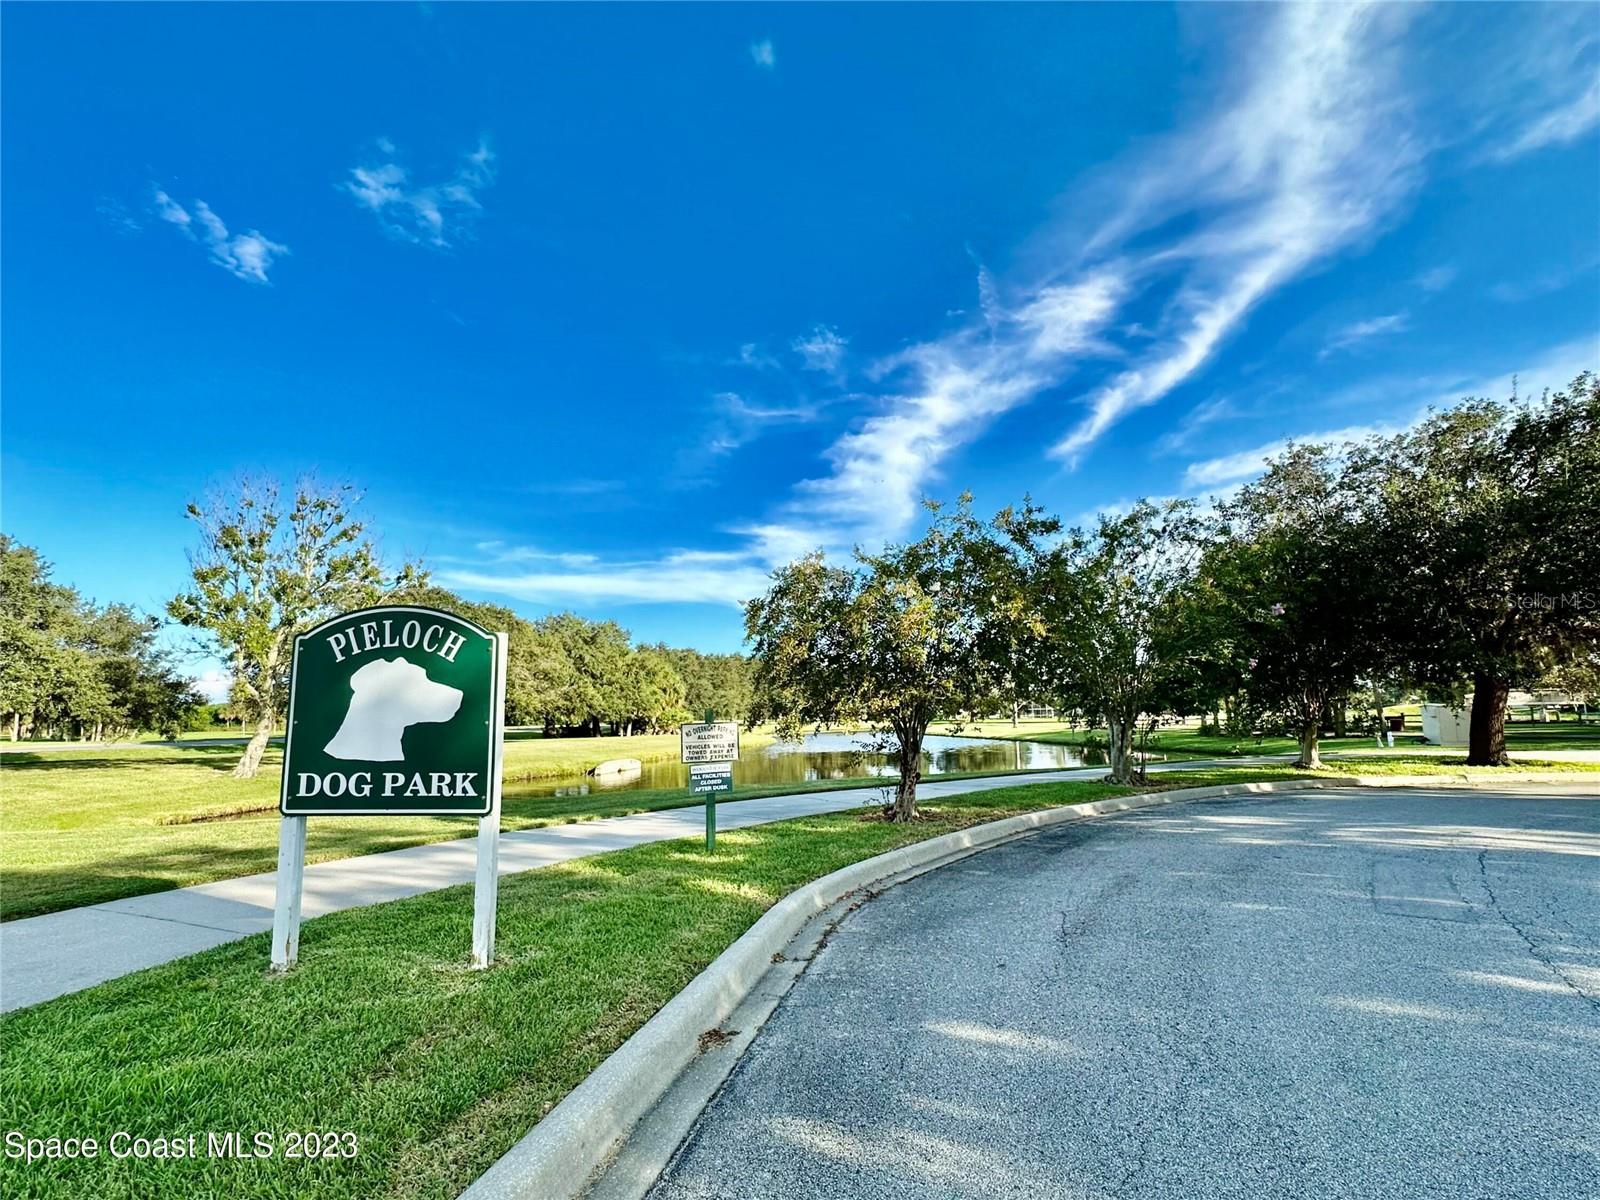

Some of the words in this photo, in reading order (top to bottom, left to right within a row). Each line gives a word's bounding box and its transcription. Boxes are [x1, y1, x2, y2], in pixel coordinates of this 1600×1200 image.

[326, 619, 467, 663] PIELOCH
[296, 771, 373, 797] DOG
[381, 772, 478, 797] PARK
